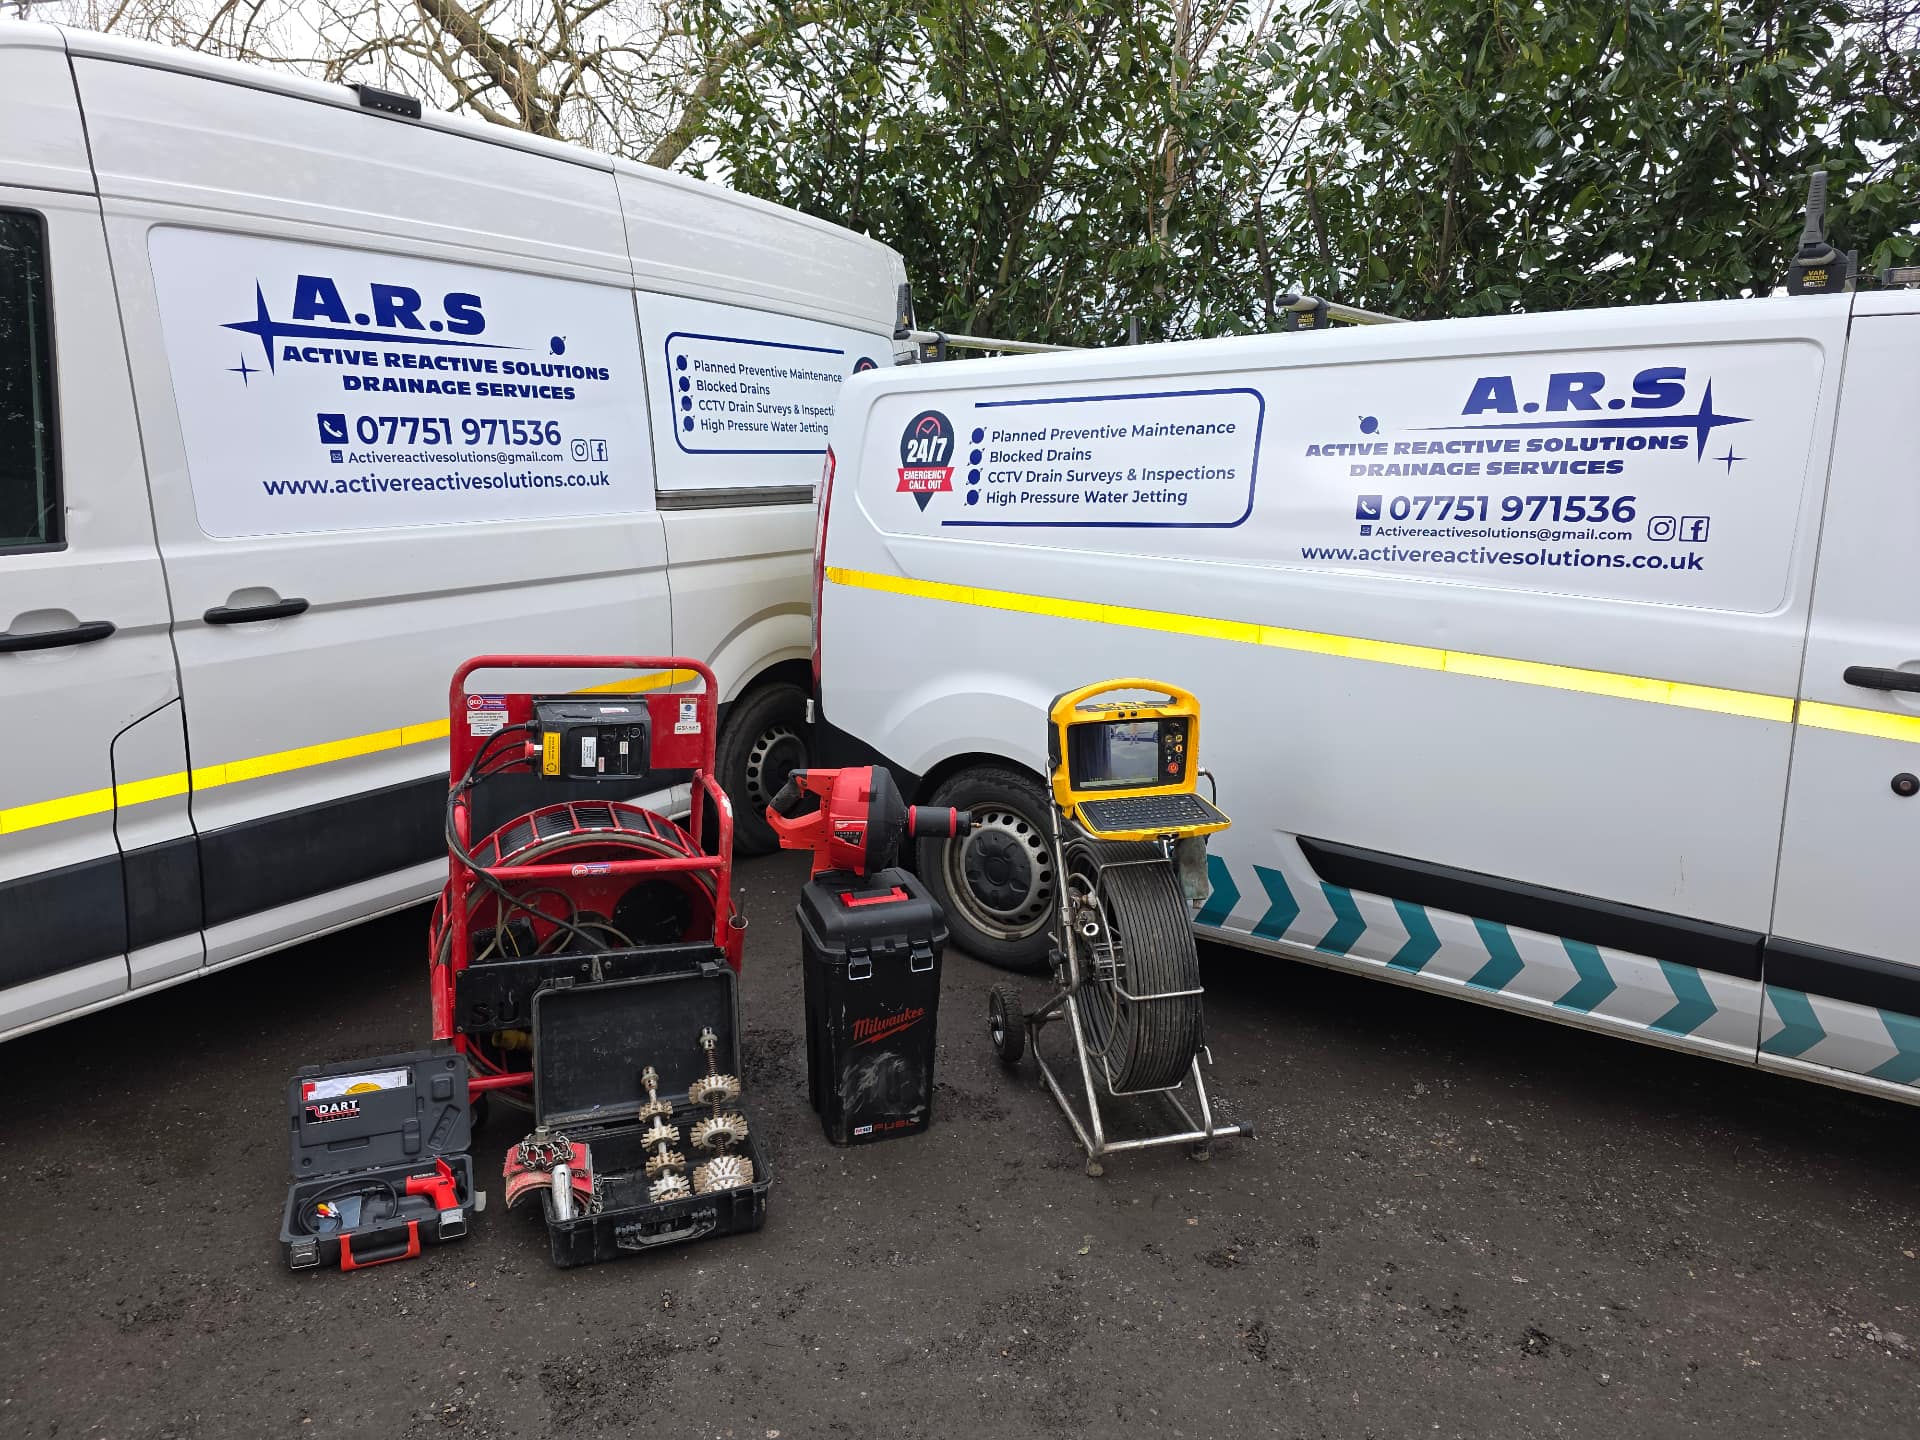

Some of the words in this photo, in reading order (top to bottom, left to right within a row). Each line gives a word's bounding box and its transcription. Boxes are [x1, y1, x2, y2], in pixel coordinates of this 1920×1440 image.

[292, 275, 485, 335] A.R.S
[283, 346, 378, 366] ACTIVE
[384, 353, 498, 373] REACTIVE
[502, 361, 609, 380] SOLUTIONS
[694, 360, 736, 374] Planned
[739, 364, 787, 378] Preventive
[790, 368, 842, 382] Maintenance
[343, 375, 471, 395] DRAINAGE
[476, 382, 575, 400] SERVICES
[696, 380, 737, 393] Blocked
[740, 383, 770, 395] Drains
[1461, 367, 1686, 415] A.R.S
[699, 400, 725, 411] CCTV
[728, 401, 754, 412] Drain
[757, 403, 792, 416] Surveys
[794, 404, 800, 414] &
[802, 405, 834, 418] Inspecti
[357, 416, 452, 445] 07751
[462, 418, 561, 445] 971536
[701, 418, 724, 433] High
[728, 420, 768, 431] Pressure
[771, 421, 797, 432] Water
[800, 422, 828, 435] Jetting
[992, 428, 1046, 442] Planned
[1051, 425, 1127, 440] Preventive
[1132, 423, 1235, 437] Maintenance
[906, 435, 948, 463] 24/7
[1306, 443, 1388, 456] ACTIVE
[1394, 440, 1520, 455] REACTIVE
[1526, 435, 1688, 452] SOLUTIONS
[349, 451, 563, 464] Activereactivesolutions@gmail.com
[990, 449, 1043, 463] Blocked
[1047, 450, 1091, 461] Drains
[903, 470, 947, 480] EMERGENCY
[988, 471, 1023, 483] CCTV
[1026, 469, 1062, 482] Drain
[1066, 470, 1122, 484] Surveys
[1127, 468, 1136, 481] &
[1142, 466, 1235, 483] Inspections
[1351, 463, 1480, 476] DRAINAGE
[1486, 460, 1624, 475] SERVICES
[263, 471, 610, 495] www.activereactivesolutions.co.uk
[909, 480, 926, 490] CALL
[927, 479, 942, 489] OUT
[987, 491, 1016, 506] High
[1021, 492, 1079, 503] Pressure
[1085, 491, 1128, 503] Water
[1132, 489, 1187, 505] Jetting
[1390, 496, 1488, 521] 07751
[1501, 496, 1636, 523] 971536
[1375, 526, 1632, 541] Activereactivesolutions@gmail.com
[1302, 545, 1704, 570] www.activereactivesolutions.co.uk
[853, 1007, 925, 1041] Milwaukee
[319, 1100, 358, 1114] DART
